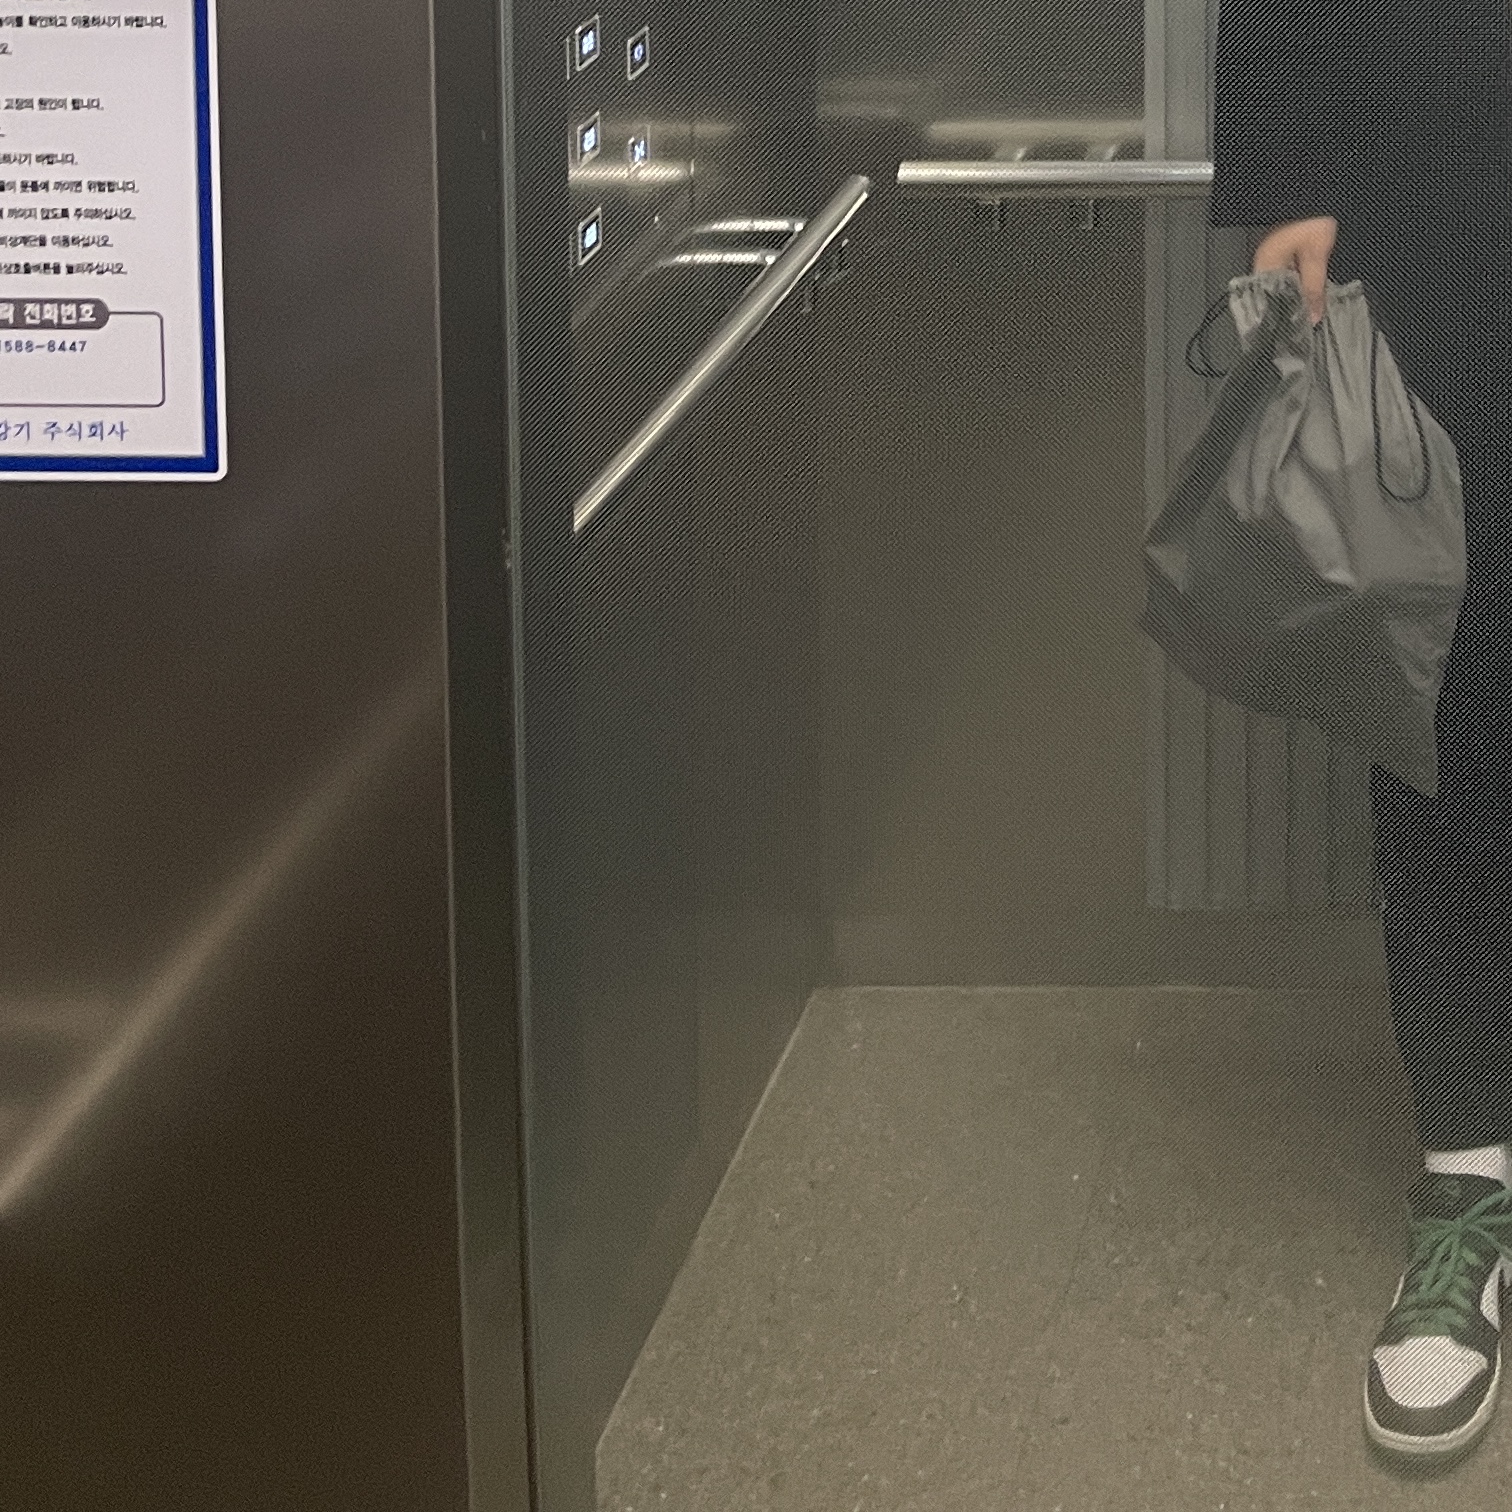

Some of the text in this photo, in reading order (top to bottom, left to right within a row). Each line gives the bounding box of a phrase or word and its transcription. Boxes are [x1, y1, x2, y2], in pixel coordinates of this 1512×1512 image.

[0, 262, 61, 275] 상호출버튼을
[24, 302, 97, 325] 전화번호
[0, 339, 87, 353] 588-8447
[43, 419, 129, 442] 주식회사
